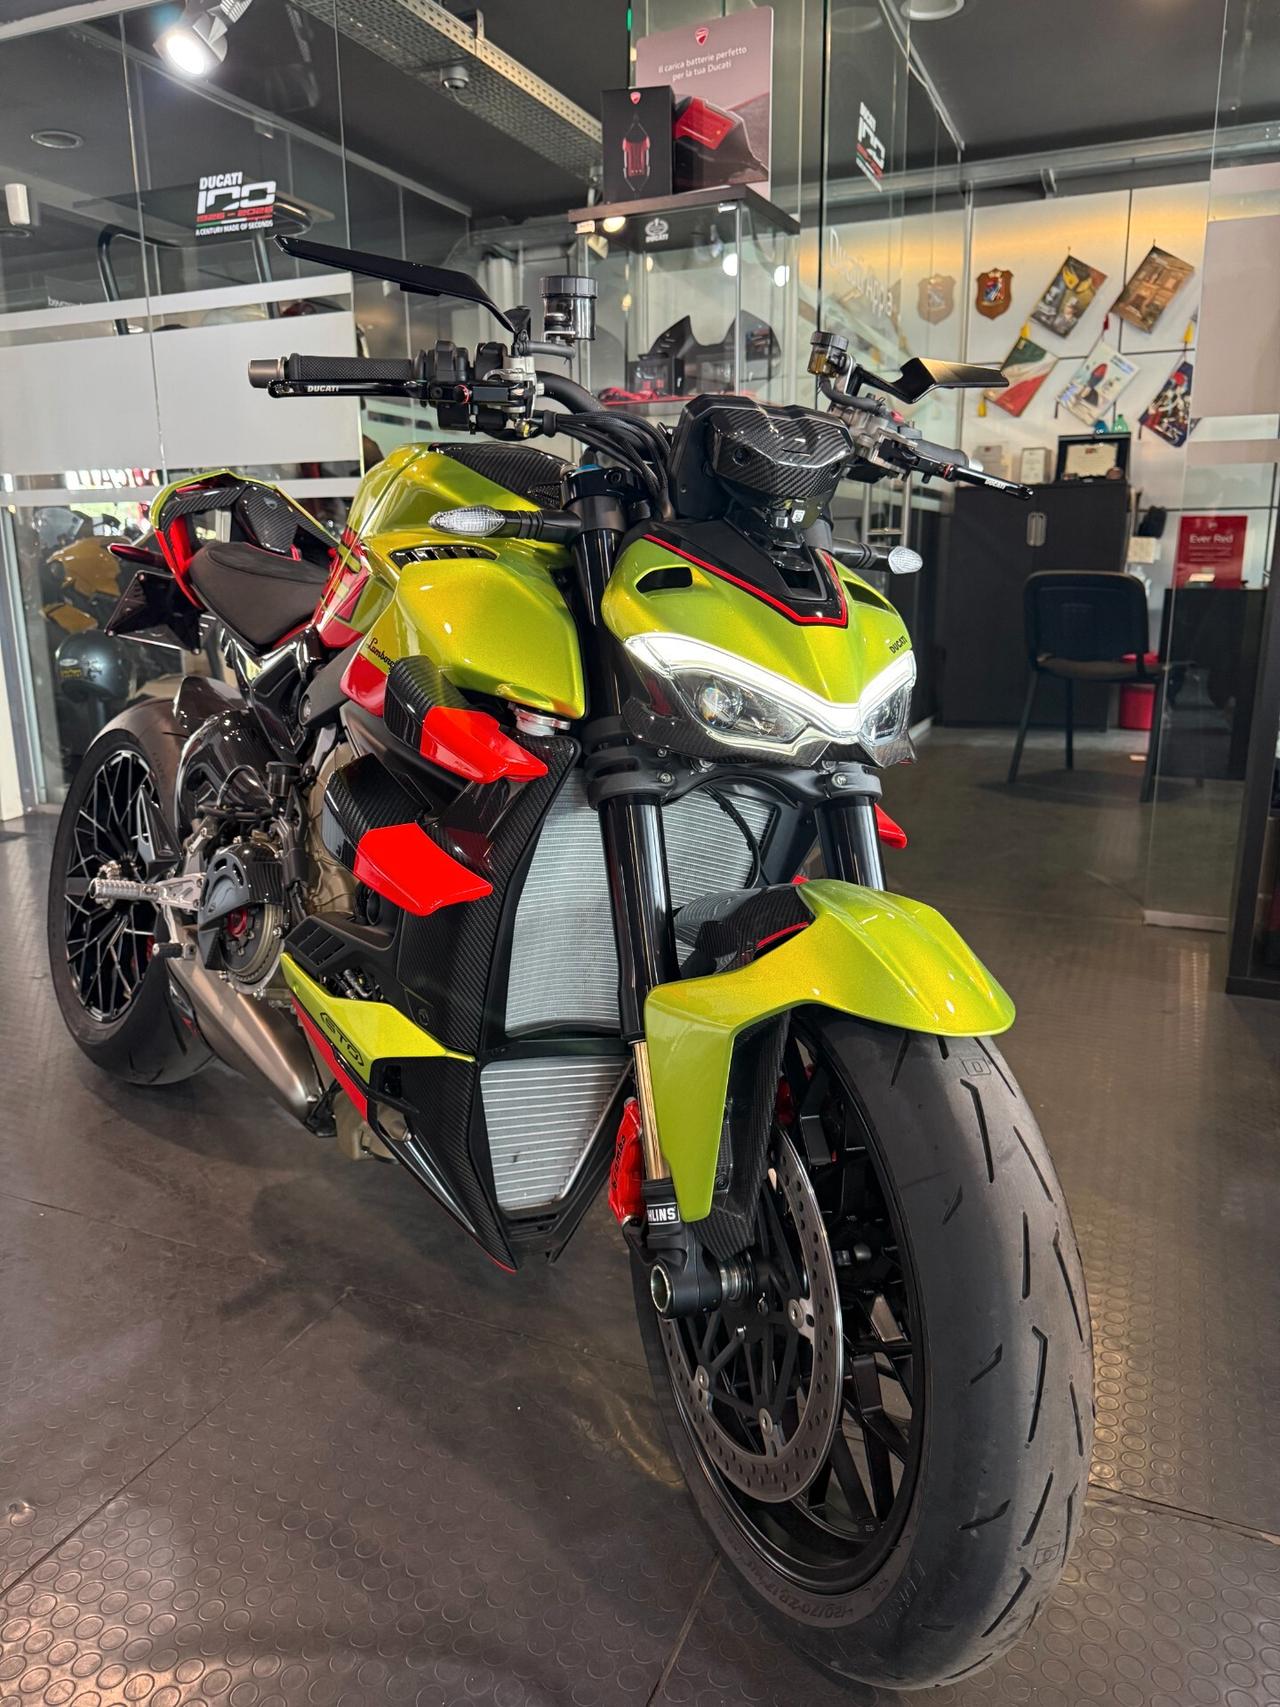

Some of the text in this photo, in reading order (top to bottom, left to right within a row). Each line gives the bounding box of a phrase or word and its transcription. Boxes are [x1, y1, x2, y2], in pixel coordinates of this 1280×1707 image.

[658, 46, 748, 73] Il carica batterie perfetto
[672, 60, 732, 82] per la tua Ducati
[199, 171, 243, 190] DUCATI
[200, 225, 223, 235] CENTURY
[223, 223, 240, 233] MADE
[240, 221, 248, 231] OF
[248, 219, 274, 230] SECONDS
[307, 385, 339, 393] DUCATI
[1189, 533, 1234, 544] Ever Red
[889, 635, 908, 654] DUCATI
